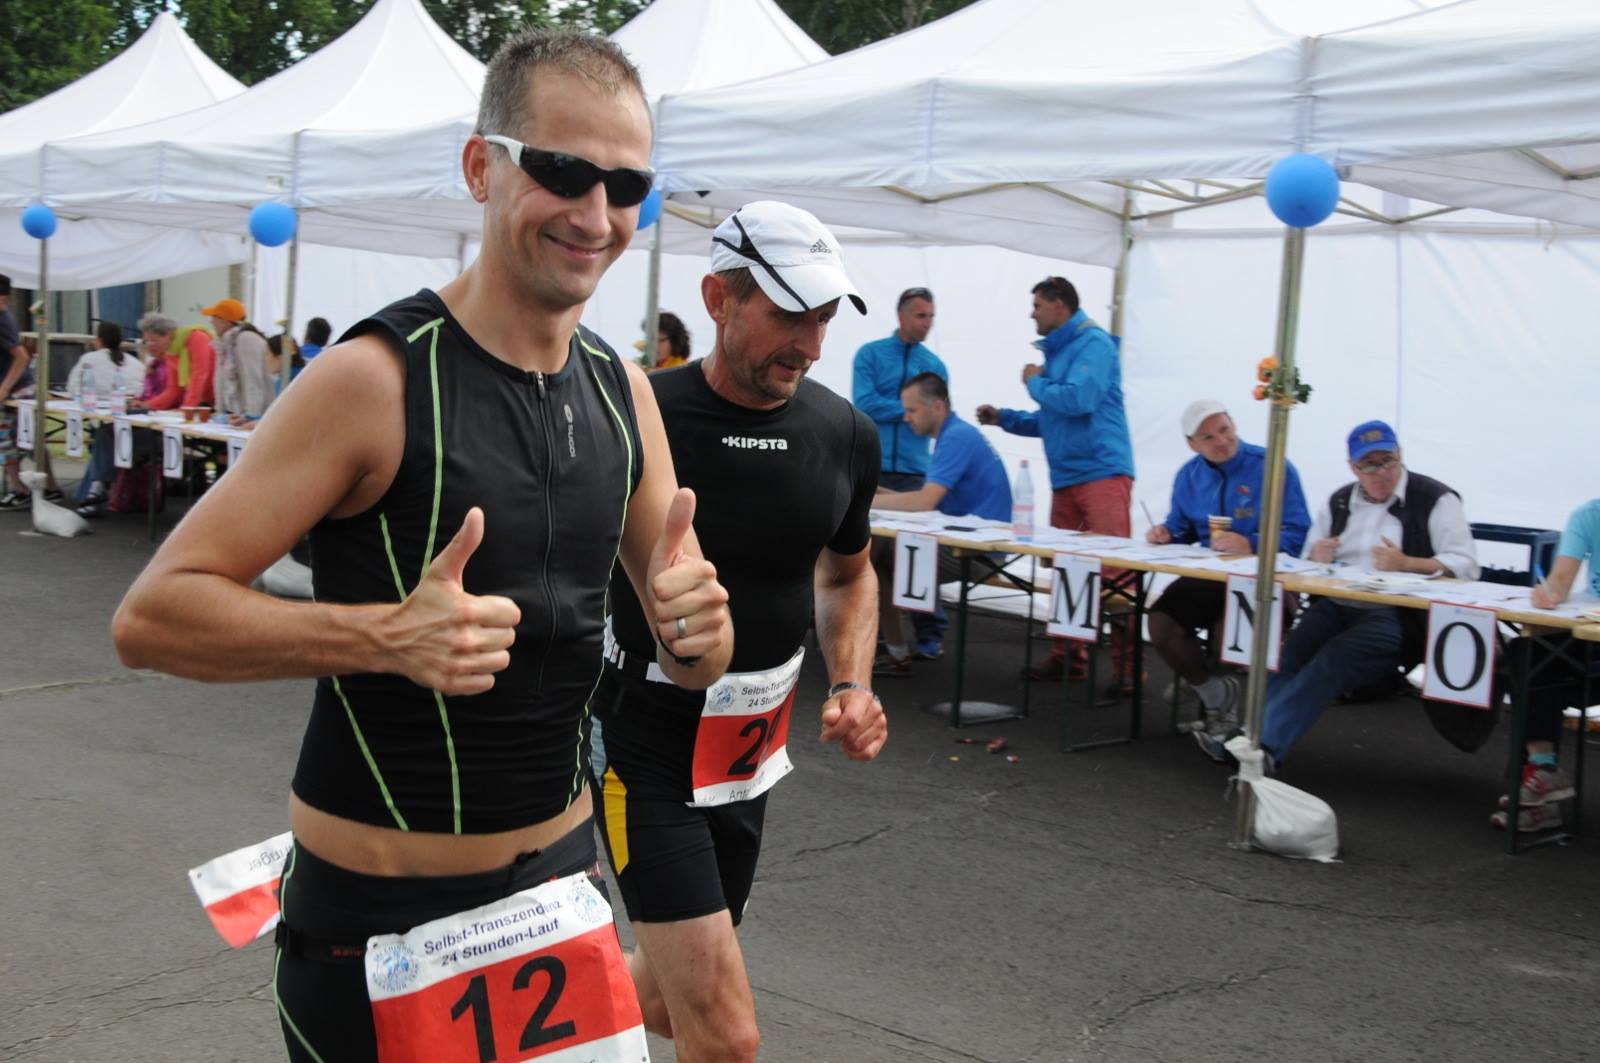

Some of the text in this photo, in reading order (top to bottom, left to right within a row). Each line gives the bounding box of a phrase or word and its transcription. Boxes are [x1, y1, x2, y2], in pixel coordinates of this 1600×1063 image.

[902, 544, 928, 601] L
[1050, 566, 1101, 629] M
[1433, 621, 1487, 691] O
[441, 949, 458, 968] 24
[462, 918, 561, 960] Stunden-Lauf
[450, 955, 577, 1063] 12
